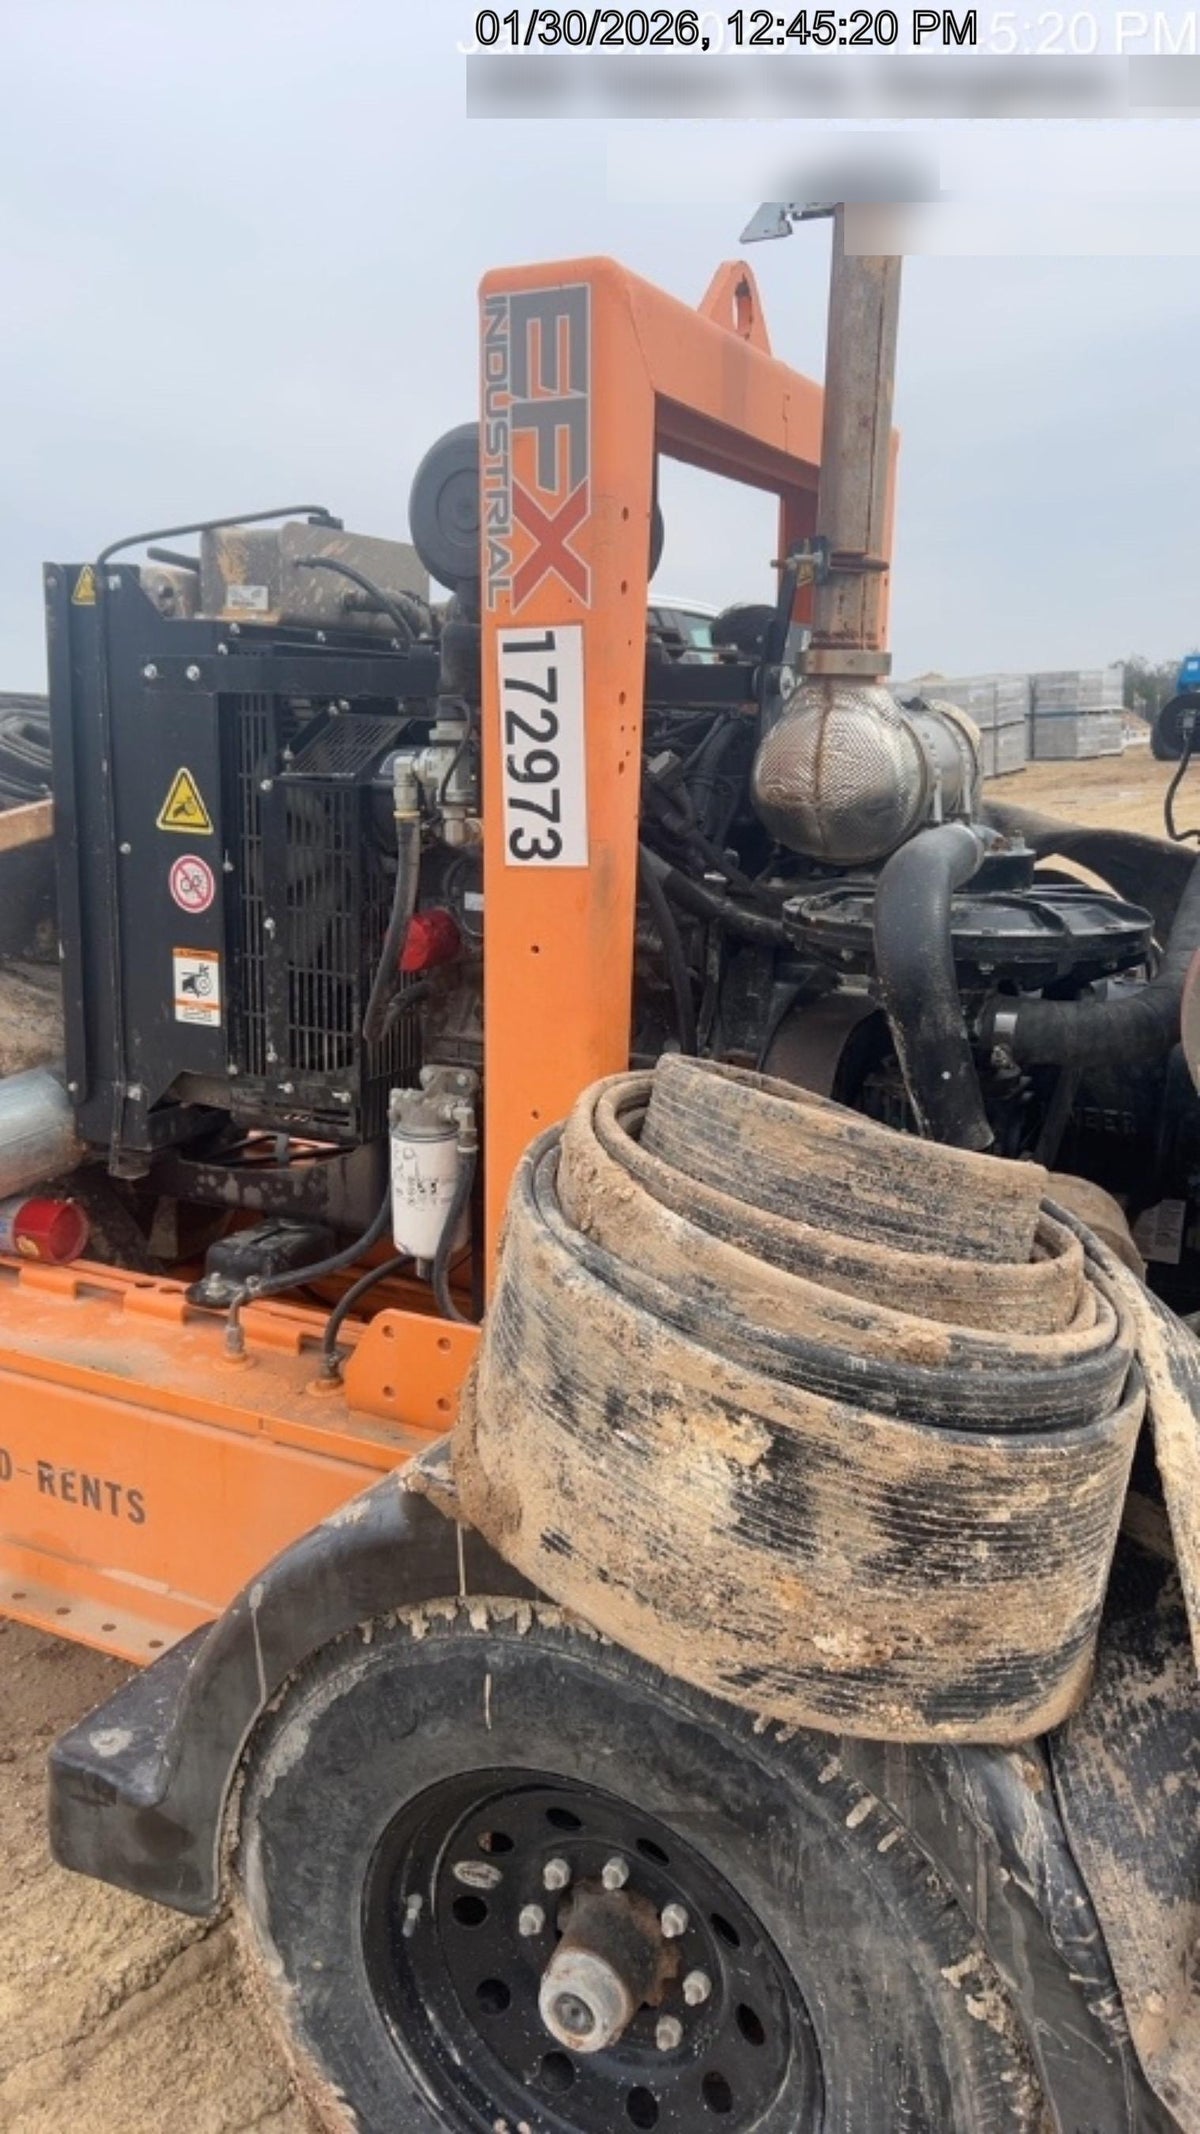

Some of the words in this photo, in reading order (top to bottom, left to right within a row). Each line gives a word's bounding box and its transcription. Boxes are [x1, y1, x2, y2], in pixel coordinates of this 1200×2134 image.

[484, 293, 513, 612] INDUSTRIAL
[508, 282, 592, 615] EFX
[502, 630, 563, 860] 172973
